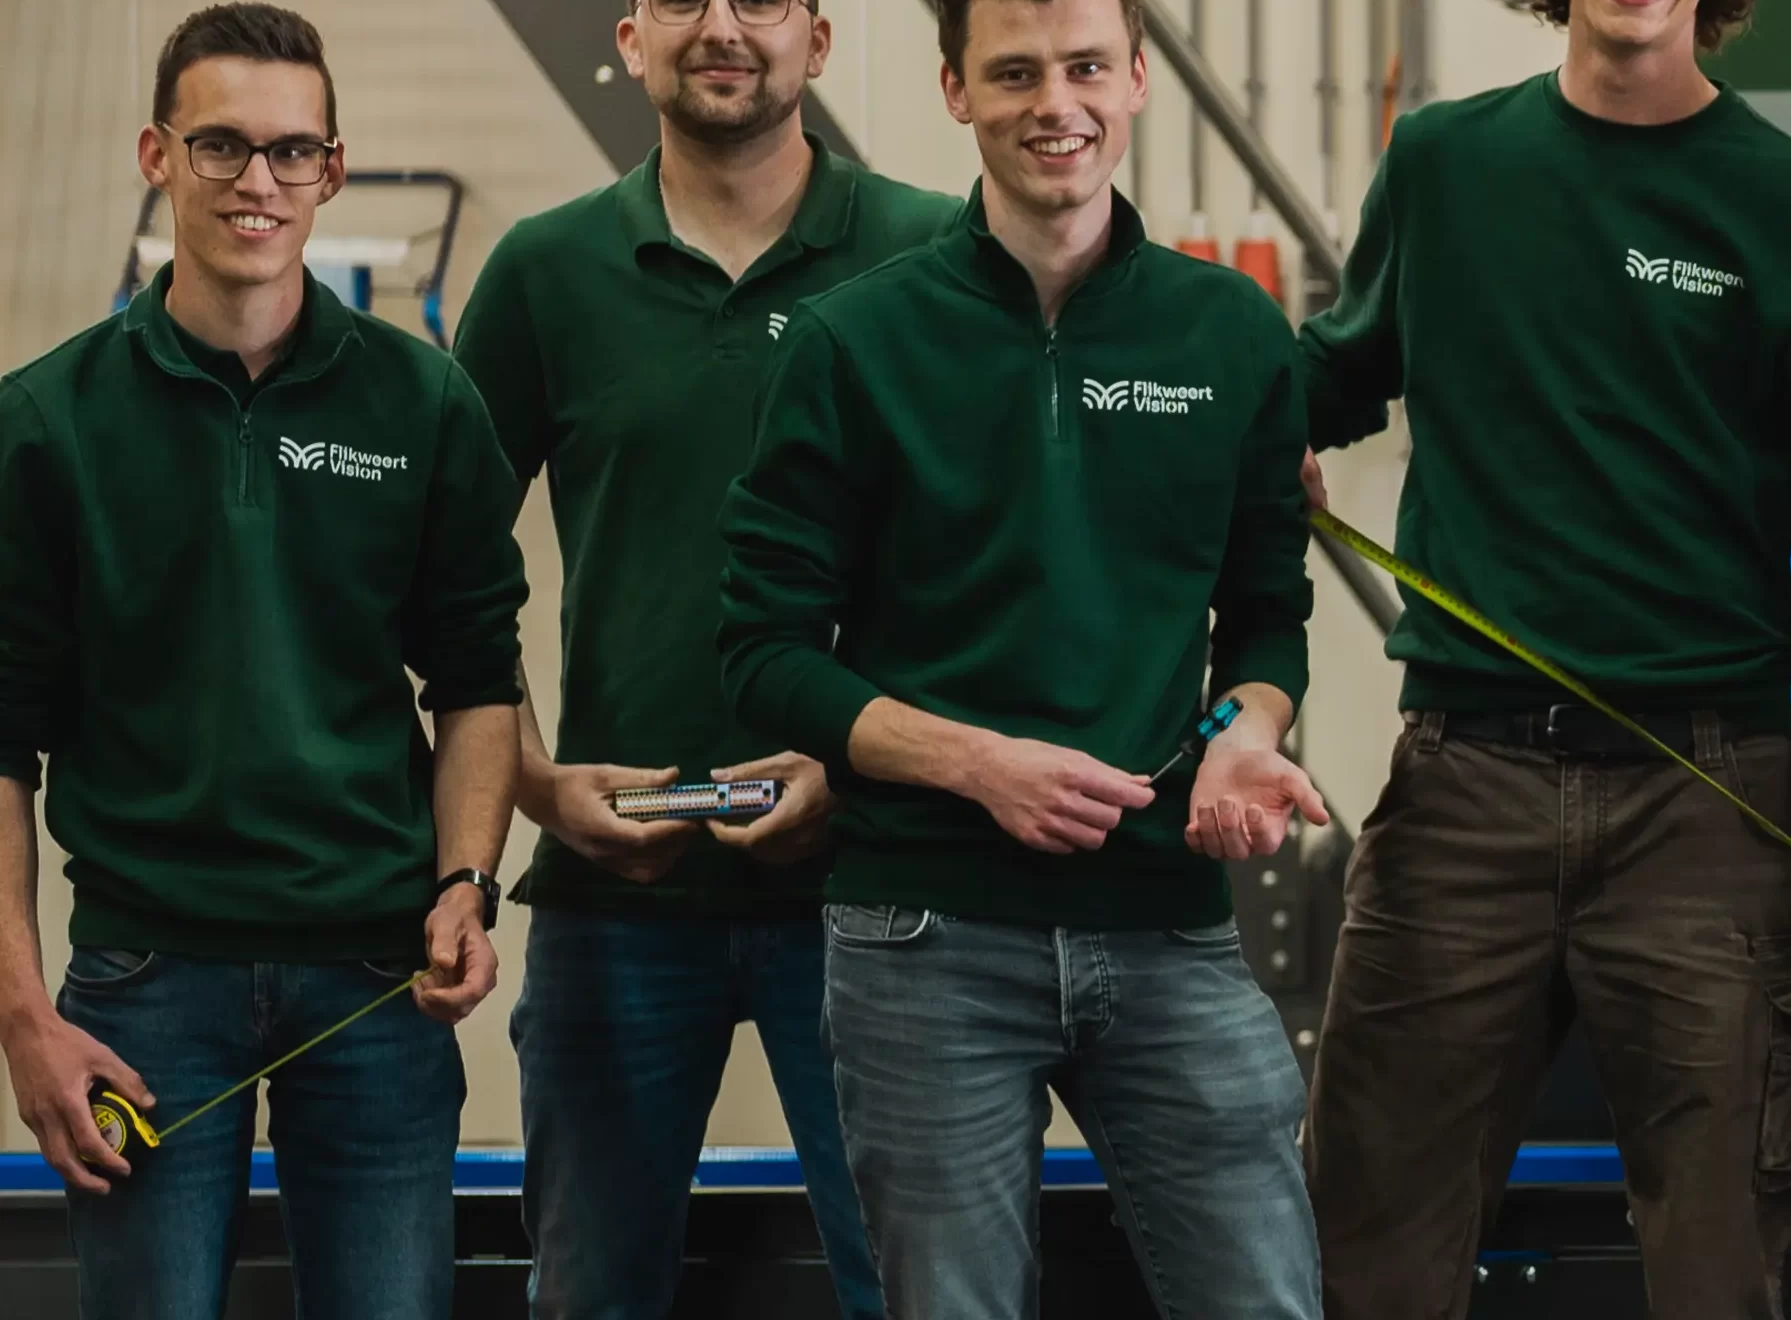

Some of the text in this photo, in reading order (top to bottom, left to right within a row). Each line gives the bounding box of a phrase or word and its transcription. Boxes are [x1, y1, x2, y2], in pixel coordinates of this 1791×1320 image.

[1672, 274, 1723, 297] Vision
[1133, 380, 1213, 401] Flikweert
[1133, 396, 1188, 414] Vision
[329, 443, 408, 469] Flikweert
[329, 458, 382, 481] Vision
